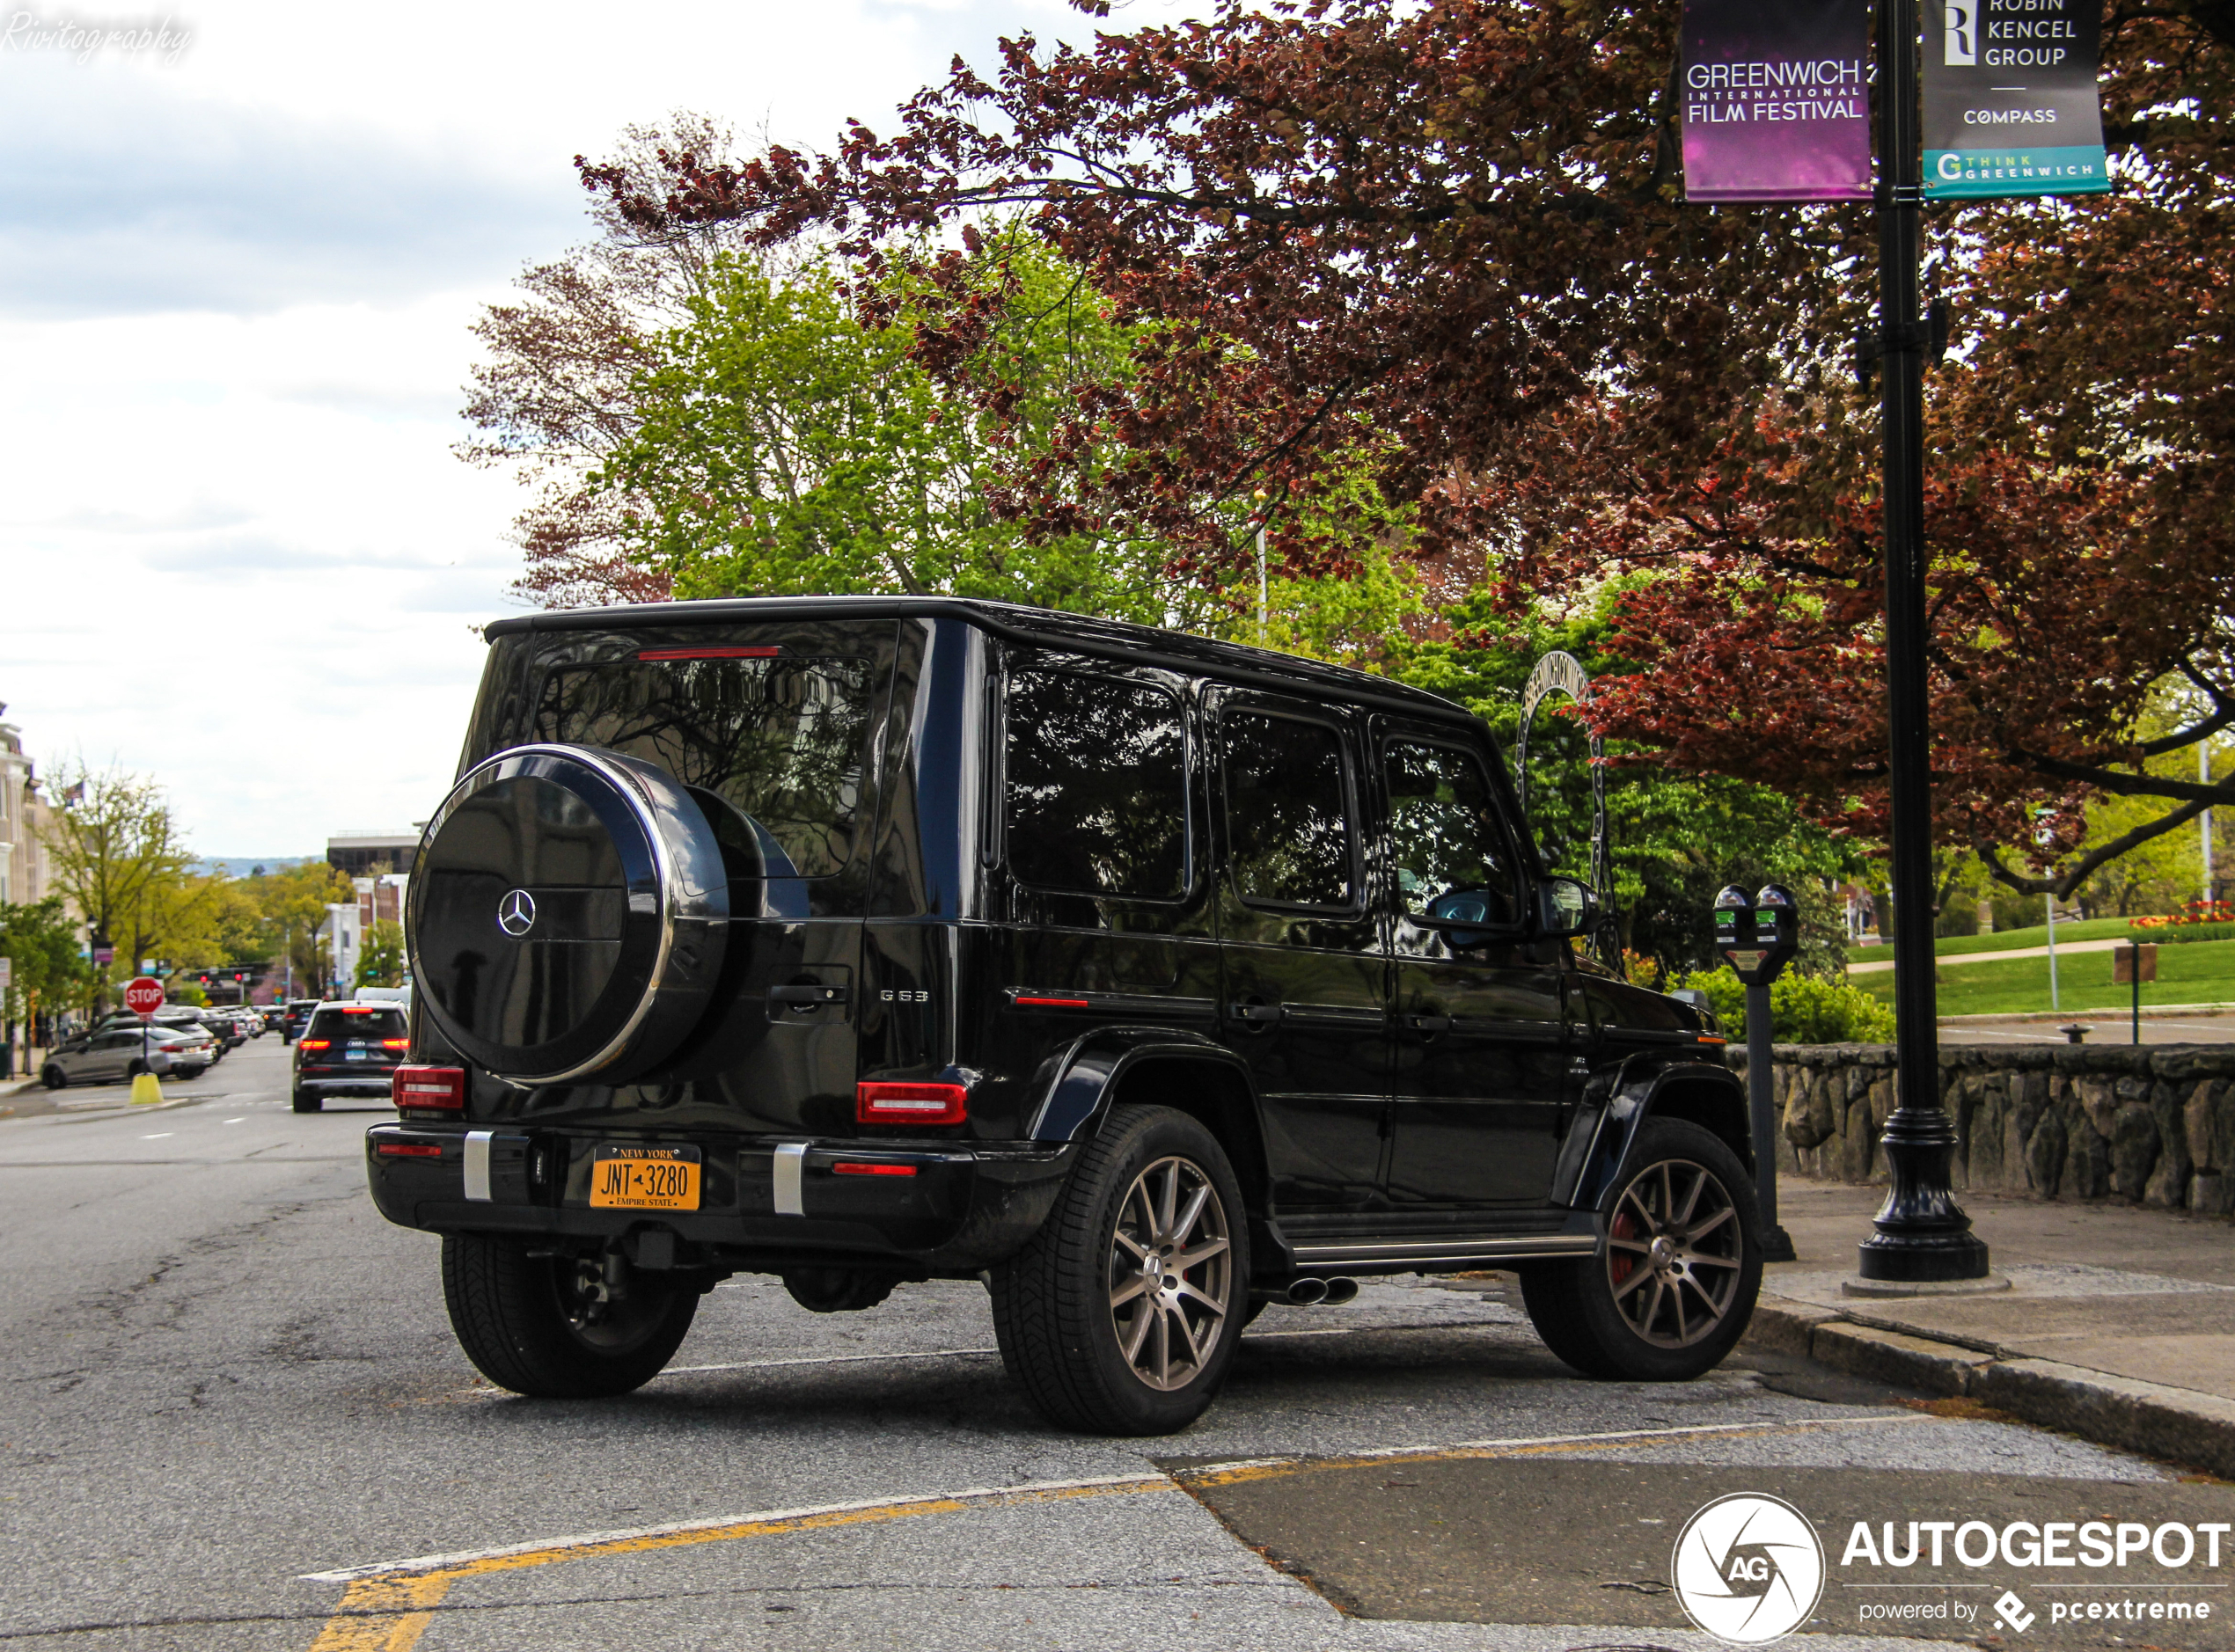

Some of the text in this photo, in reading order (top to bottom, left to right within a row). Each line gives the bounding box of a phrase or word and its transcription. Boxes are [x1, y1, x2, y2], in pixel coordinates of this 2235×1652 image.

[1988, 20, 2077, 39] KENCEL
[1985, 48, 2066, 66] GROUP
[1687, 60, 1859, 89] GREENWICH
[1688, 87, 1859, 101] INTERNATIONAL
[1689, 99, 1863, 123] FILM FESTIVAL
[1963, 109, 2056, 125] COMPASS
[1965, 156, 2030, 167] THINK
[1965, 164, 2093, 179] GREENWICH
[128, 988, 162, 1004] STOP
[620, 1149, 674, 1159] NEW YORK
[601, 1164, 687, 1196] JNT 3280
[617, 1197, 672, 1207] EMPIRE STATE
[1095, 1151, 1136, 1291] SCORPION
